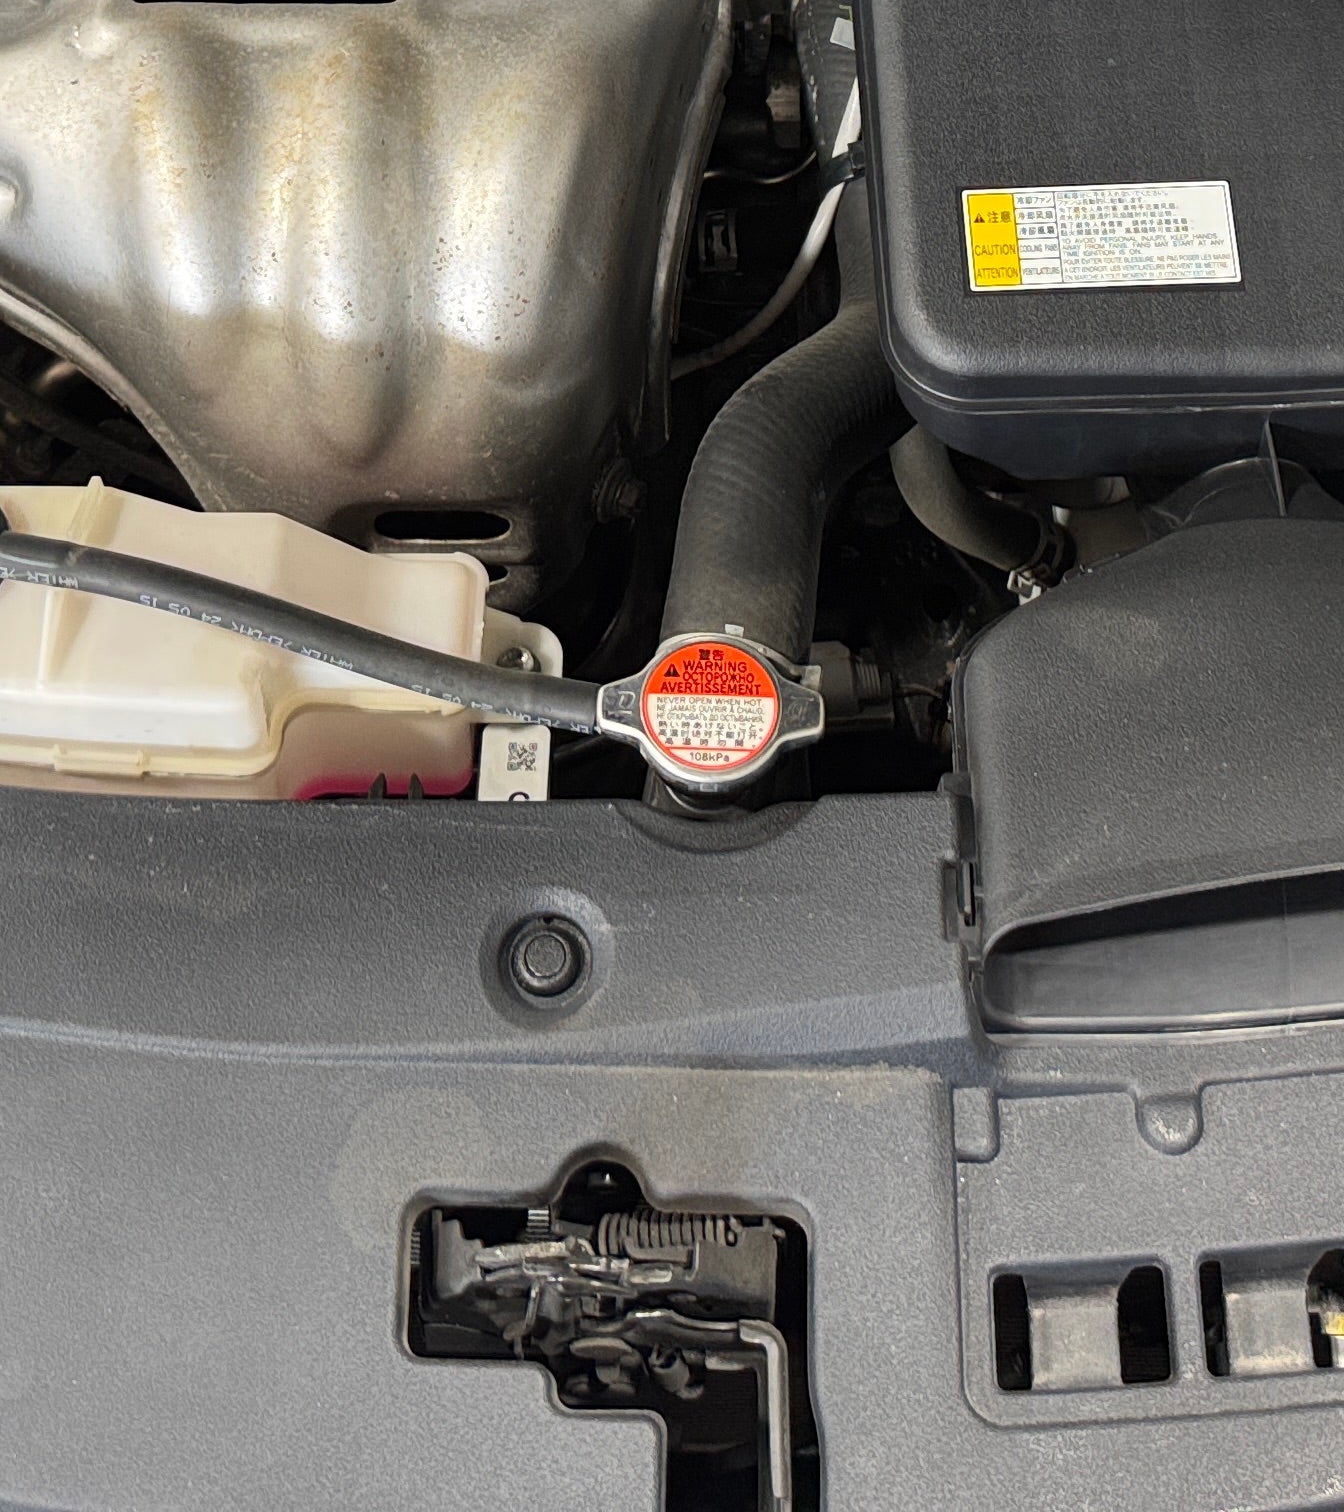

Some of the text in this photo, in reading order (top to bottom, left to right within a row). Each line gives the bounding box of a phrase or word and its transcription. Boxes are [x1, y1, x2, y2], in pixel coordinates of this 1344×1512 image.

[975, 243, 1017, 257] CAUTION
[976, 266, 1019, 280] ATTENTION
[682, 660, 747, 672] WARNING
[682, 672, 755, 683] ОСТОРОЖНО
[660, 681, 761, 695] AVERTISSEMENT
[657, 696, 687, 704] NEVER
[689, 696, 713, 705] OPEN
[715, 697, 741, 705] WHEN
[668, 704, 697, 712] JAMAIS
[699, 705, 727, 713] OUVRIR
[689, 752, 730, 763] 108kPa
